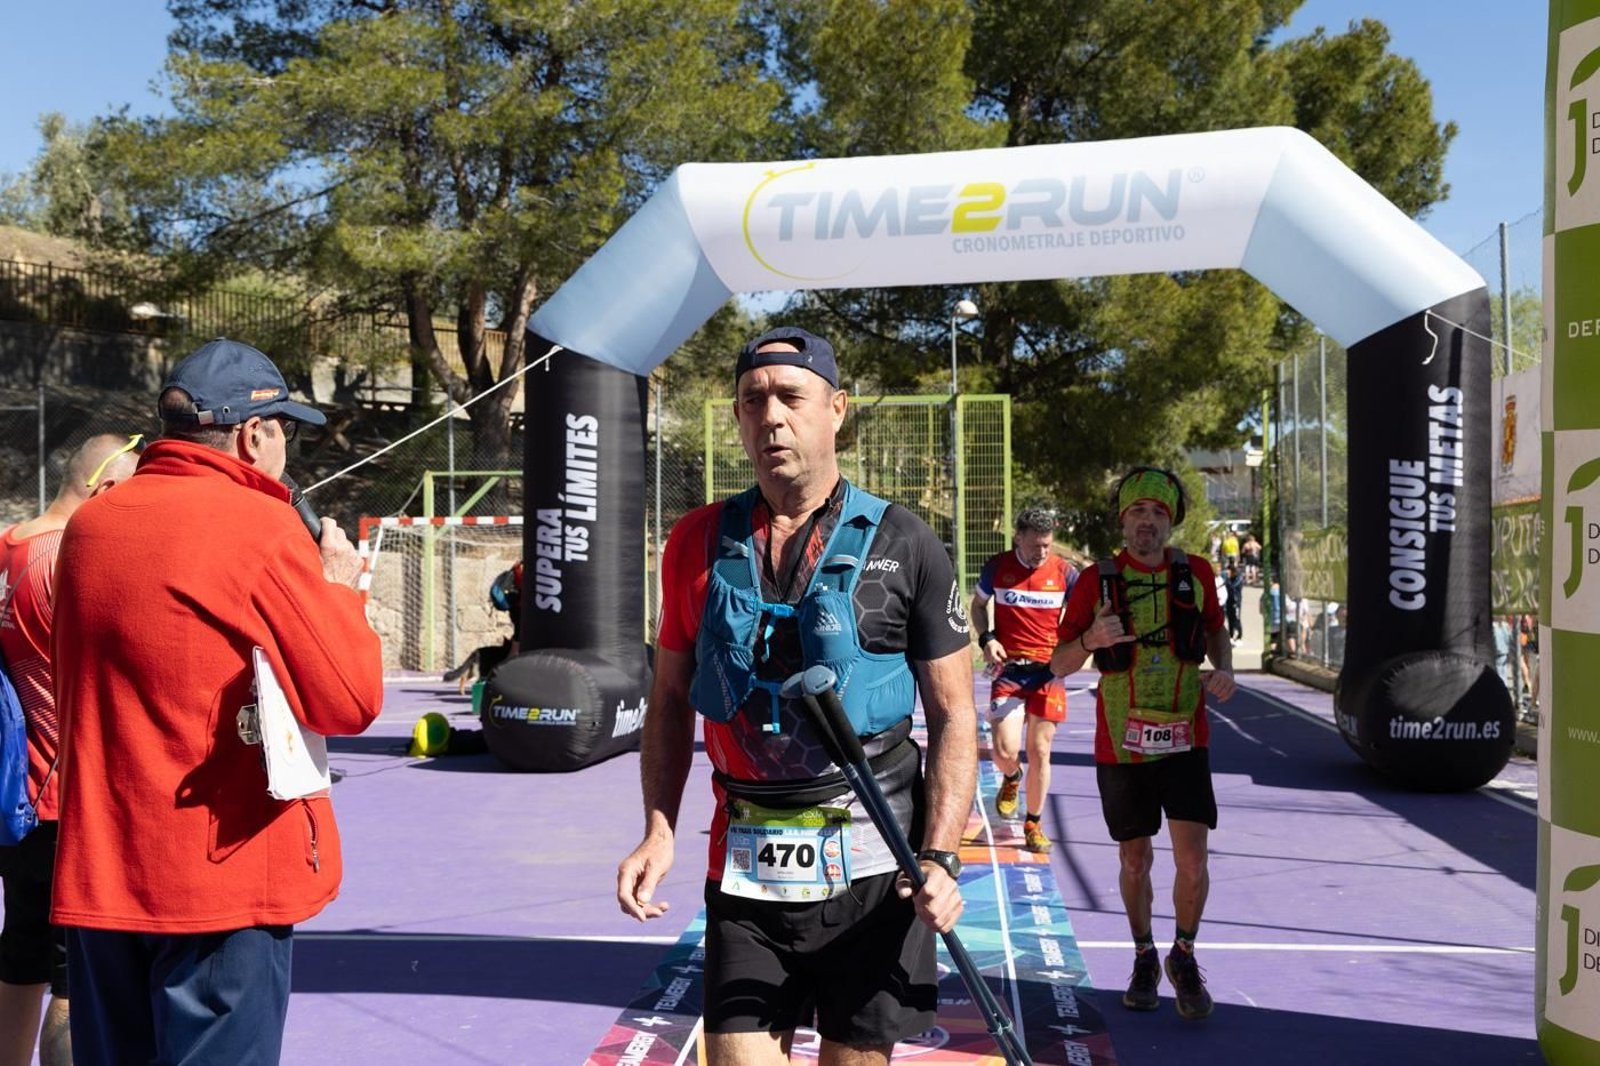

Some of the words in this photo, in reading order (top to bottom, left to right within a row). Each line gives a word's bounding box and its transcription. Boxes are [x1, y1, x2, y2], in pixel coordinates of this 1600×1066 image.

[766, 168, 1183, 242] TIME2RUN
[952, 231, 1087, 254] CRONOMETRAJE
[1089, 224, 1185, 248] DEPORTIVO
[1428, 384, 1464, 487] METAS
[557, 413, 599, 522] LÍMITES
[1428, 491, 1456, 533] TUS
[565, 525, 589, 562] TUS
[1389, 459, 1427, 611] CONSIGUE
[535, 508, 562, 614] SUPERA
[493, 705, 577, 721] TIME2RUN
[1389, 715, 1501, 740] time2run.es
[1144, 729, 1171, 742] 108
[757, 843, 816, 868] 470
